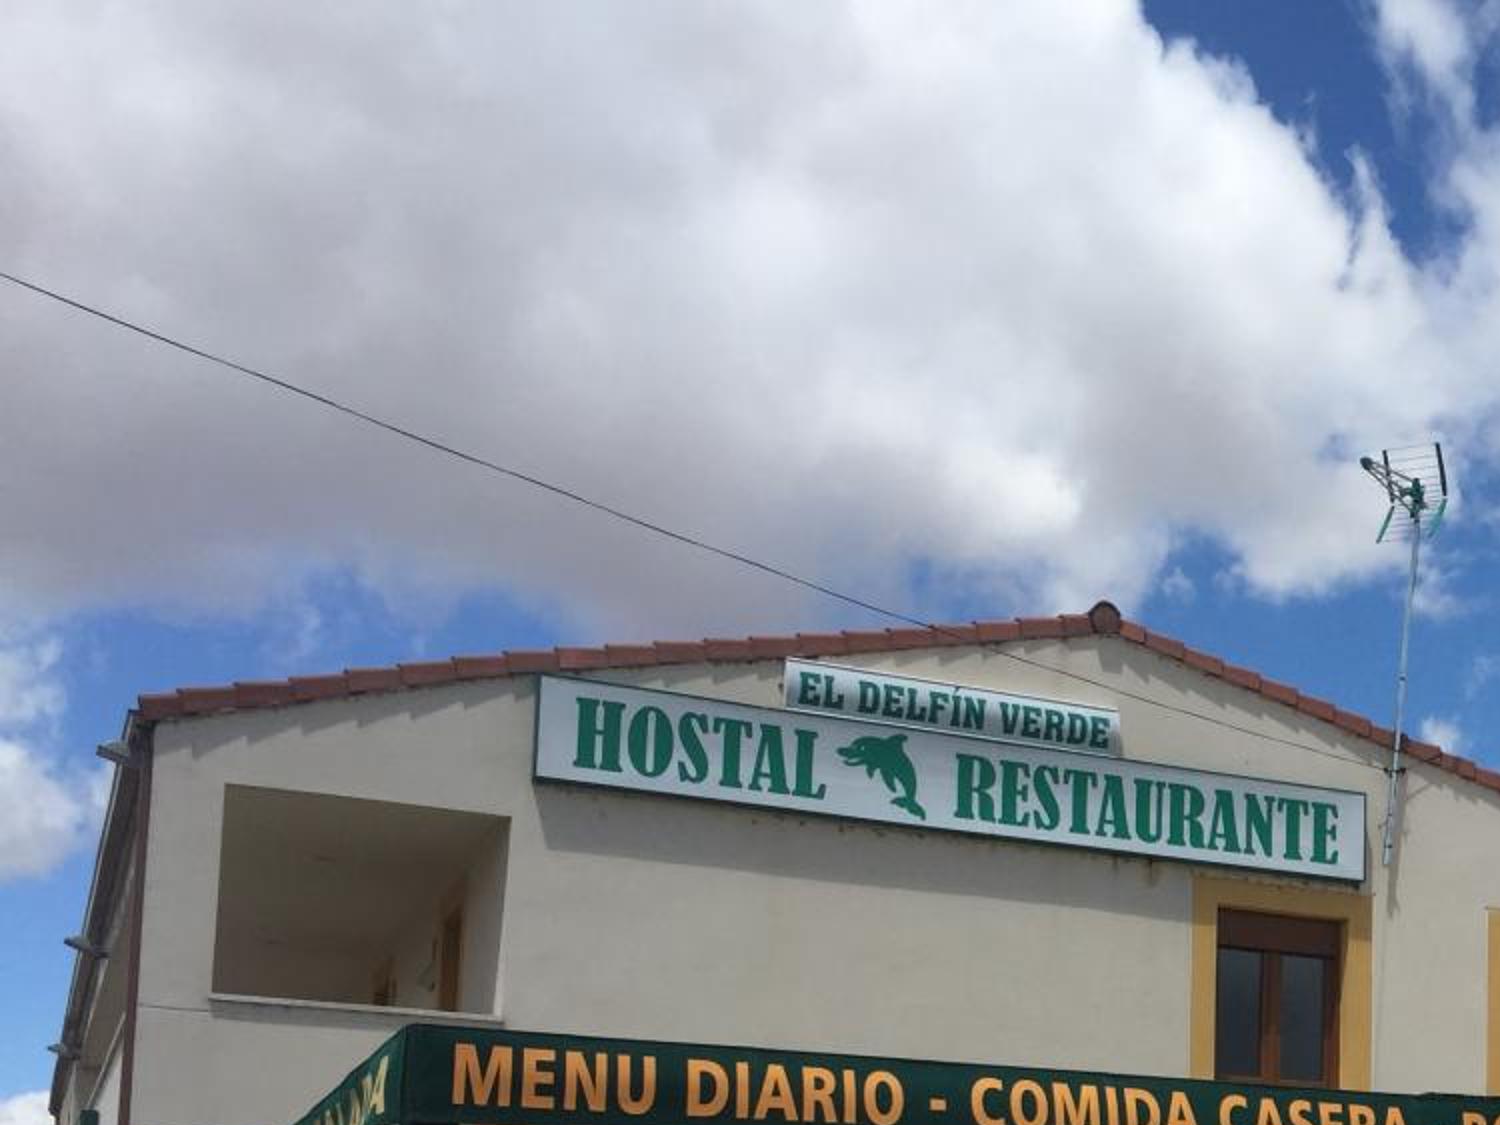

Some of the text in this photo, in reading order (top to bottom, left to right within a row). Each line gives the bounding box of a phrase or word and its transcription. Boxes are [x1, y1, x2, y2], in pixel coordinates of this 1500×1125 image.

[798, 670, 1112, 750] EL DELFÍN VERDE
[572, 696, 1340, 866] HOSTAL RESTAURANTE
[450, 1042, 657, 1116] MENU
